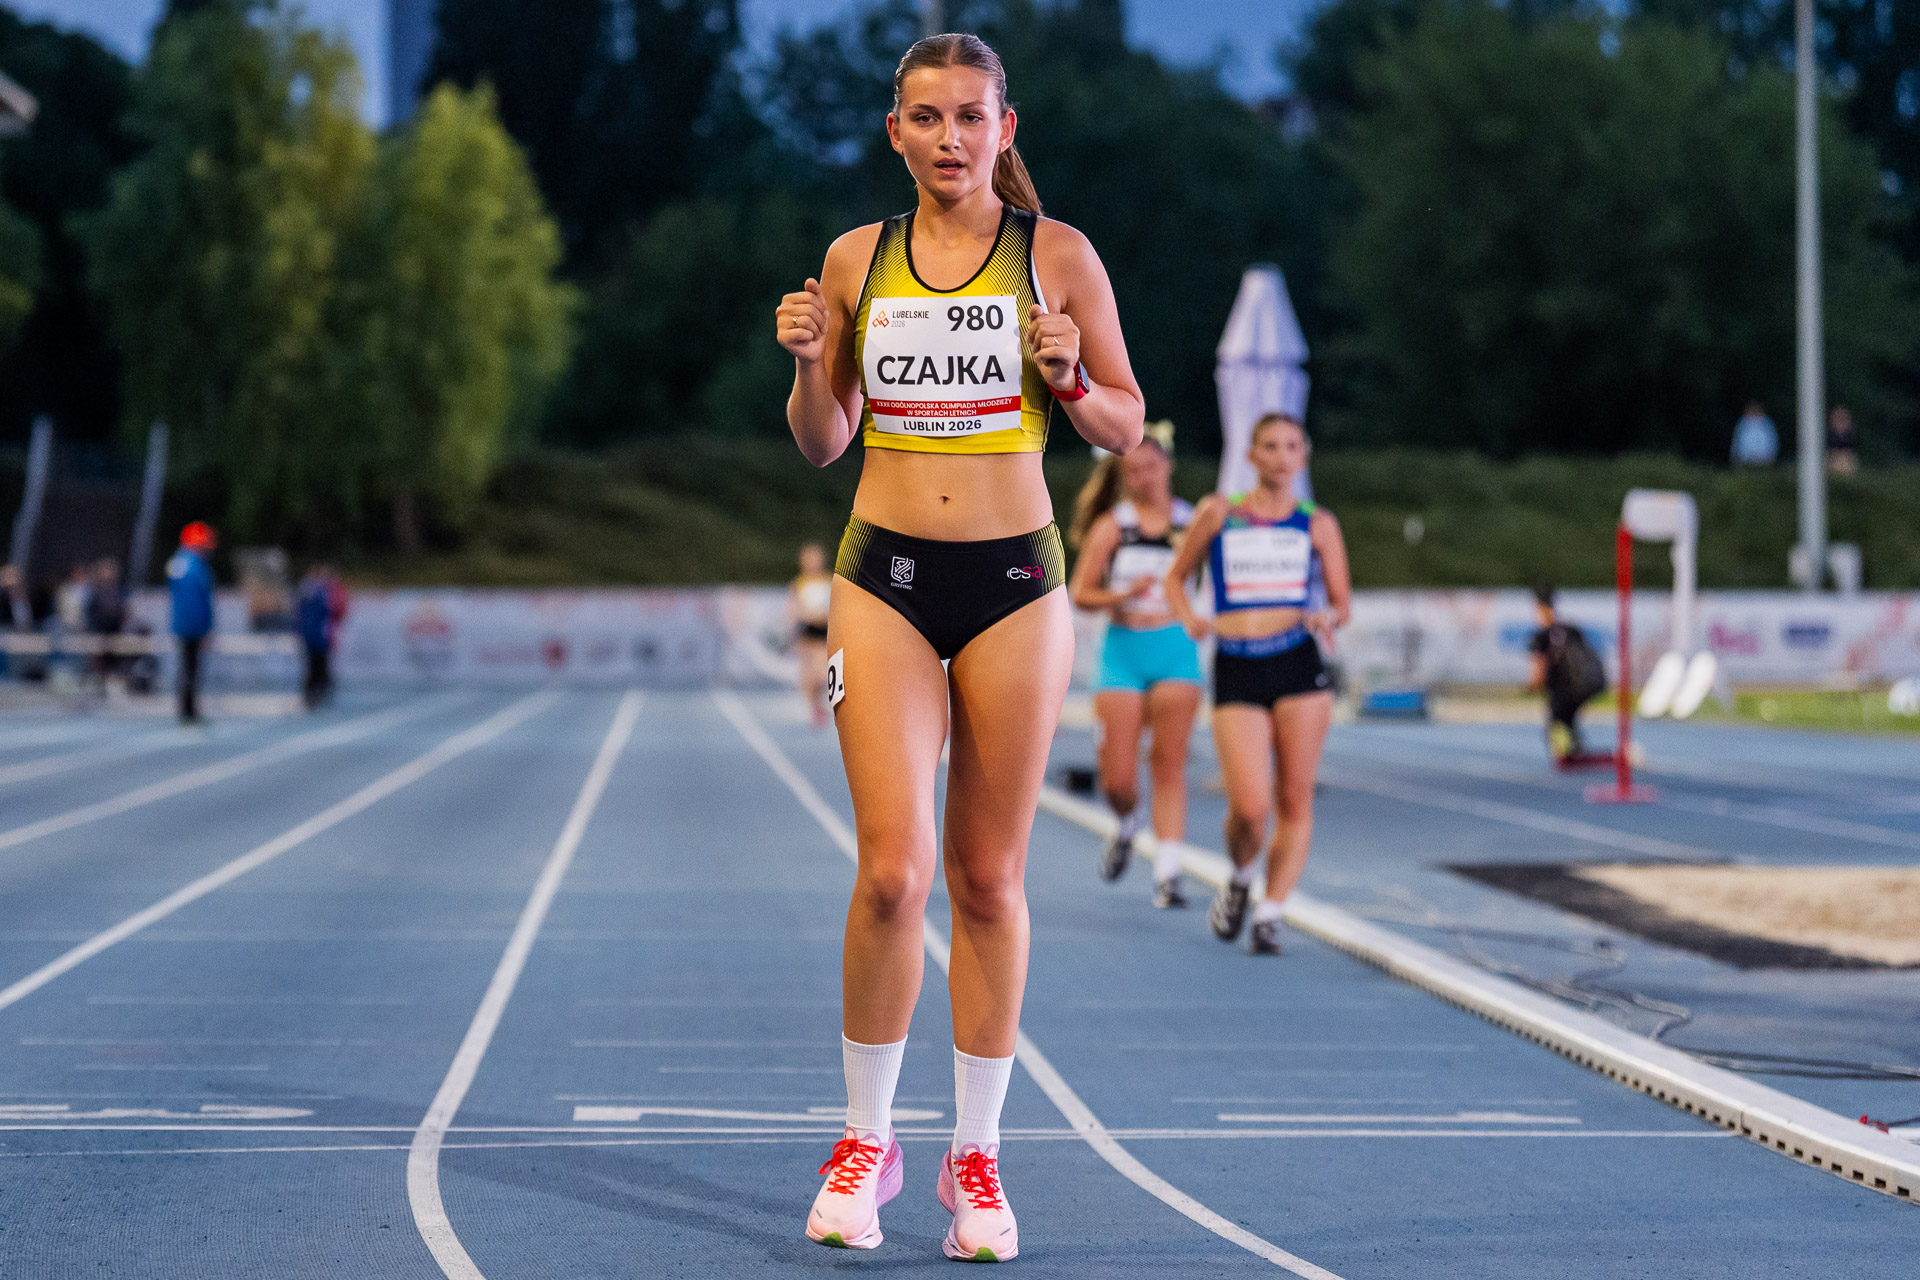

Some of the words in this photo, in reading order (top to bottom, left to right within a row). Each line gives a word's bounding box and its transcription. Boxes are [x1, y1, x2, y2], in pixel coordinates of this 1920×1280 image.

[892, 310, 929, 319] LUBELSKIE
[947, 304, 1004, 332] 980
[891, 320, 906, 328] 2026
[877, 355, 1006, 385] CZAJKA
[890, 401, 939, 409] OGÓLNOPOLSKA
[977, 398, 1013, 408] MŁODZIEŻY
[949, 409, 977, 417] LETNICH
[903, 420, 945, 432] LUBLIN
[948, 419, 982, 432] 2026
